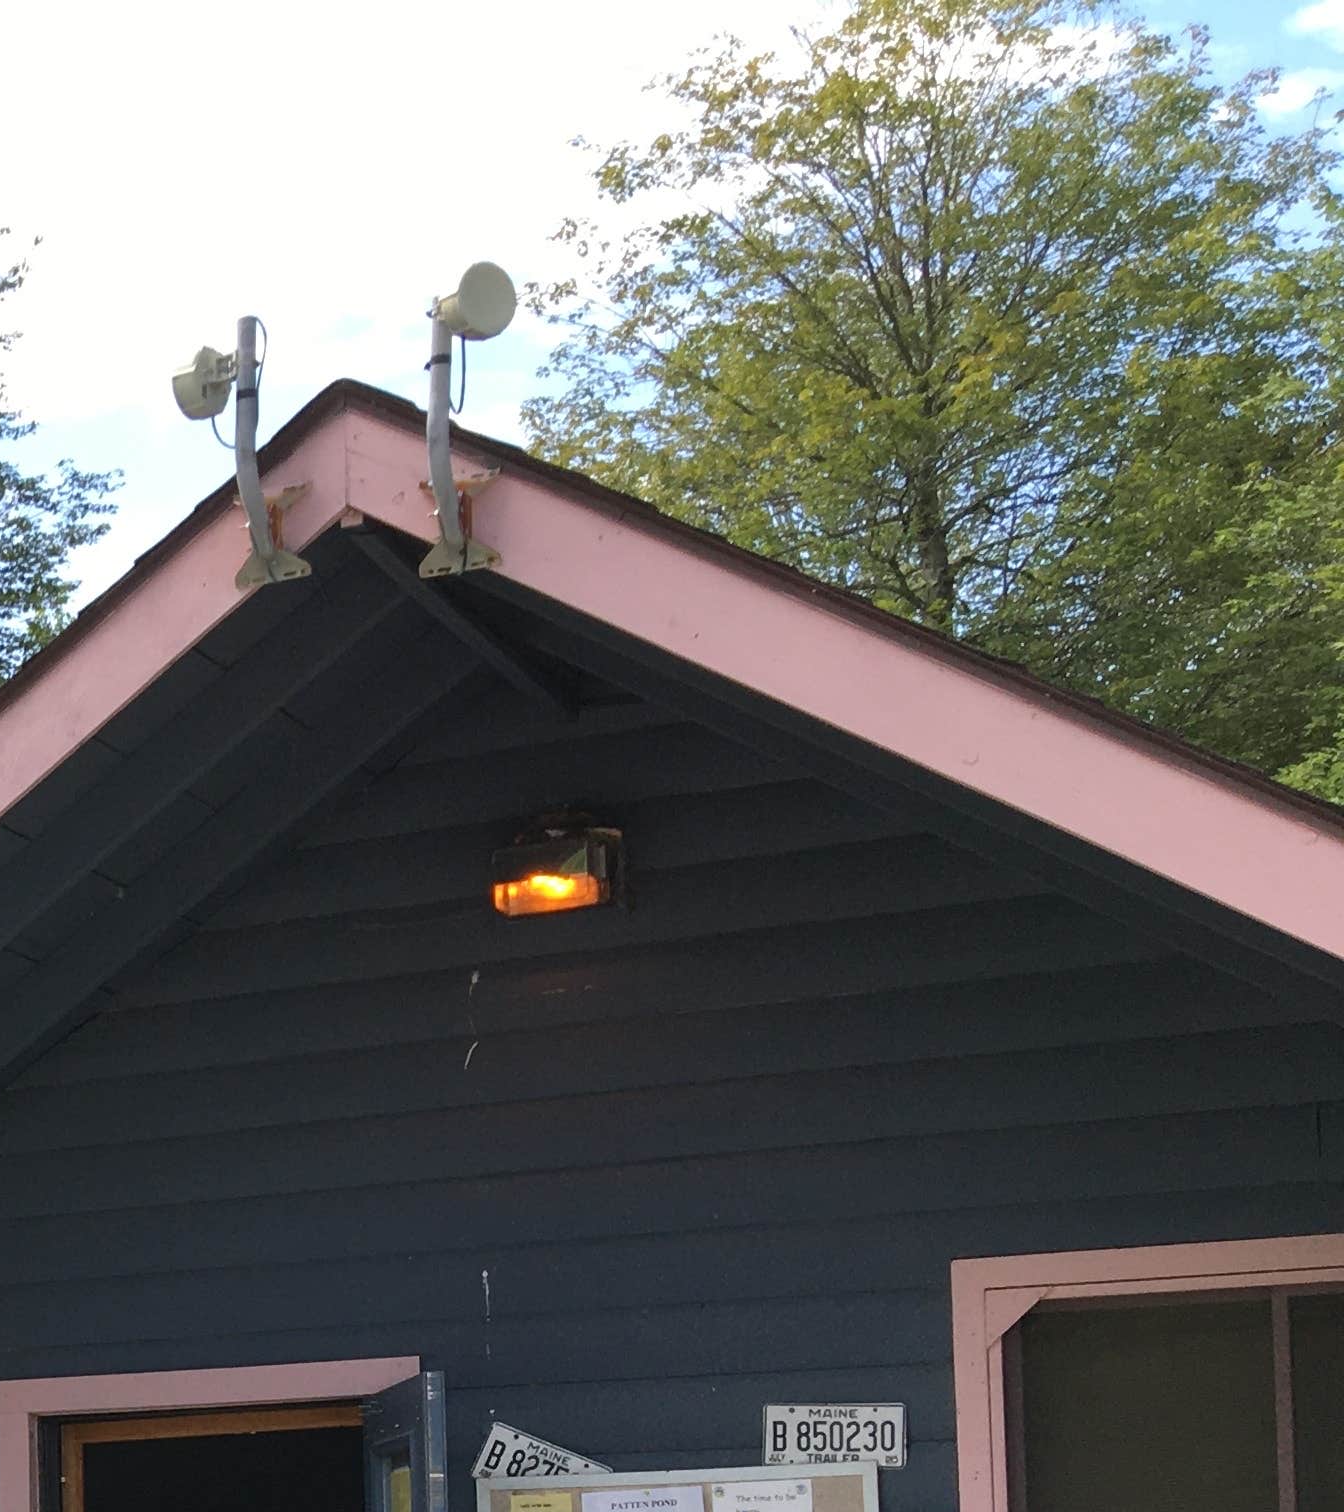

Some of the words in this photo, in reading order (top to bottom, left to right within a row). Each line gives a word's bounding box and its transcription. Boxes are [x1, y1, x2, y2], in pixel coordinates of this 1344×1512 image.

[809, 1408, 858, 1418] MAINE
[773, 1420, 787, 1451] B
[797, 1420, 895, 1452] 850230
[484, 1440, 506, 1470] B
[527, 1442, 570, 1466] MAINE
[611, 1500, 649, 1510] PATTEN
[652, 1499, 678, 1508] POND
